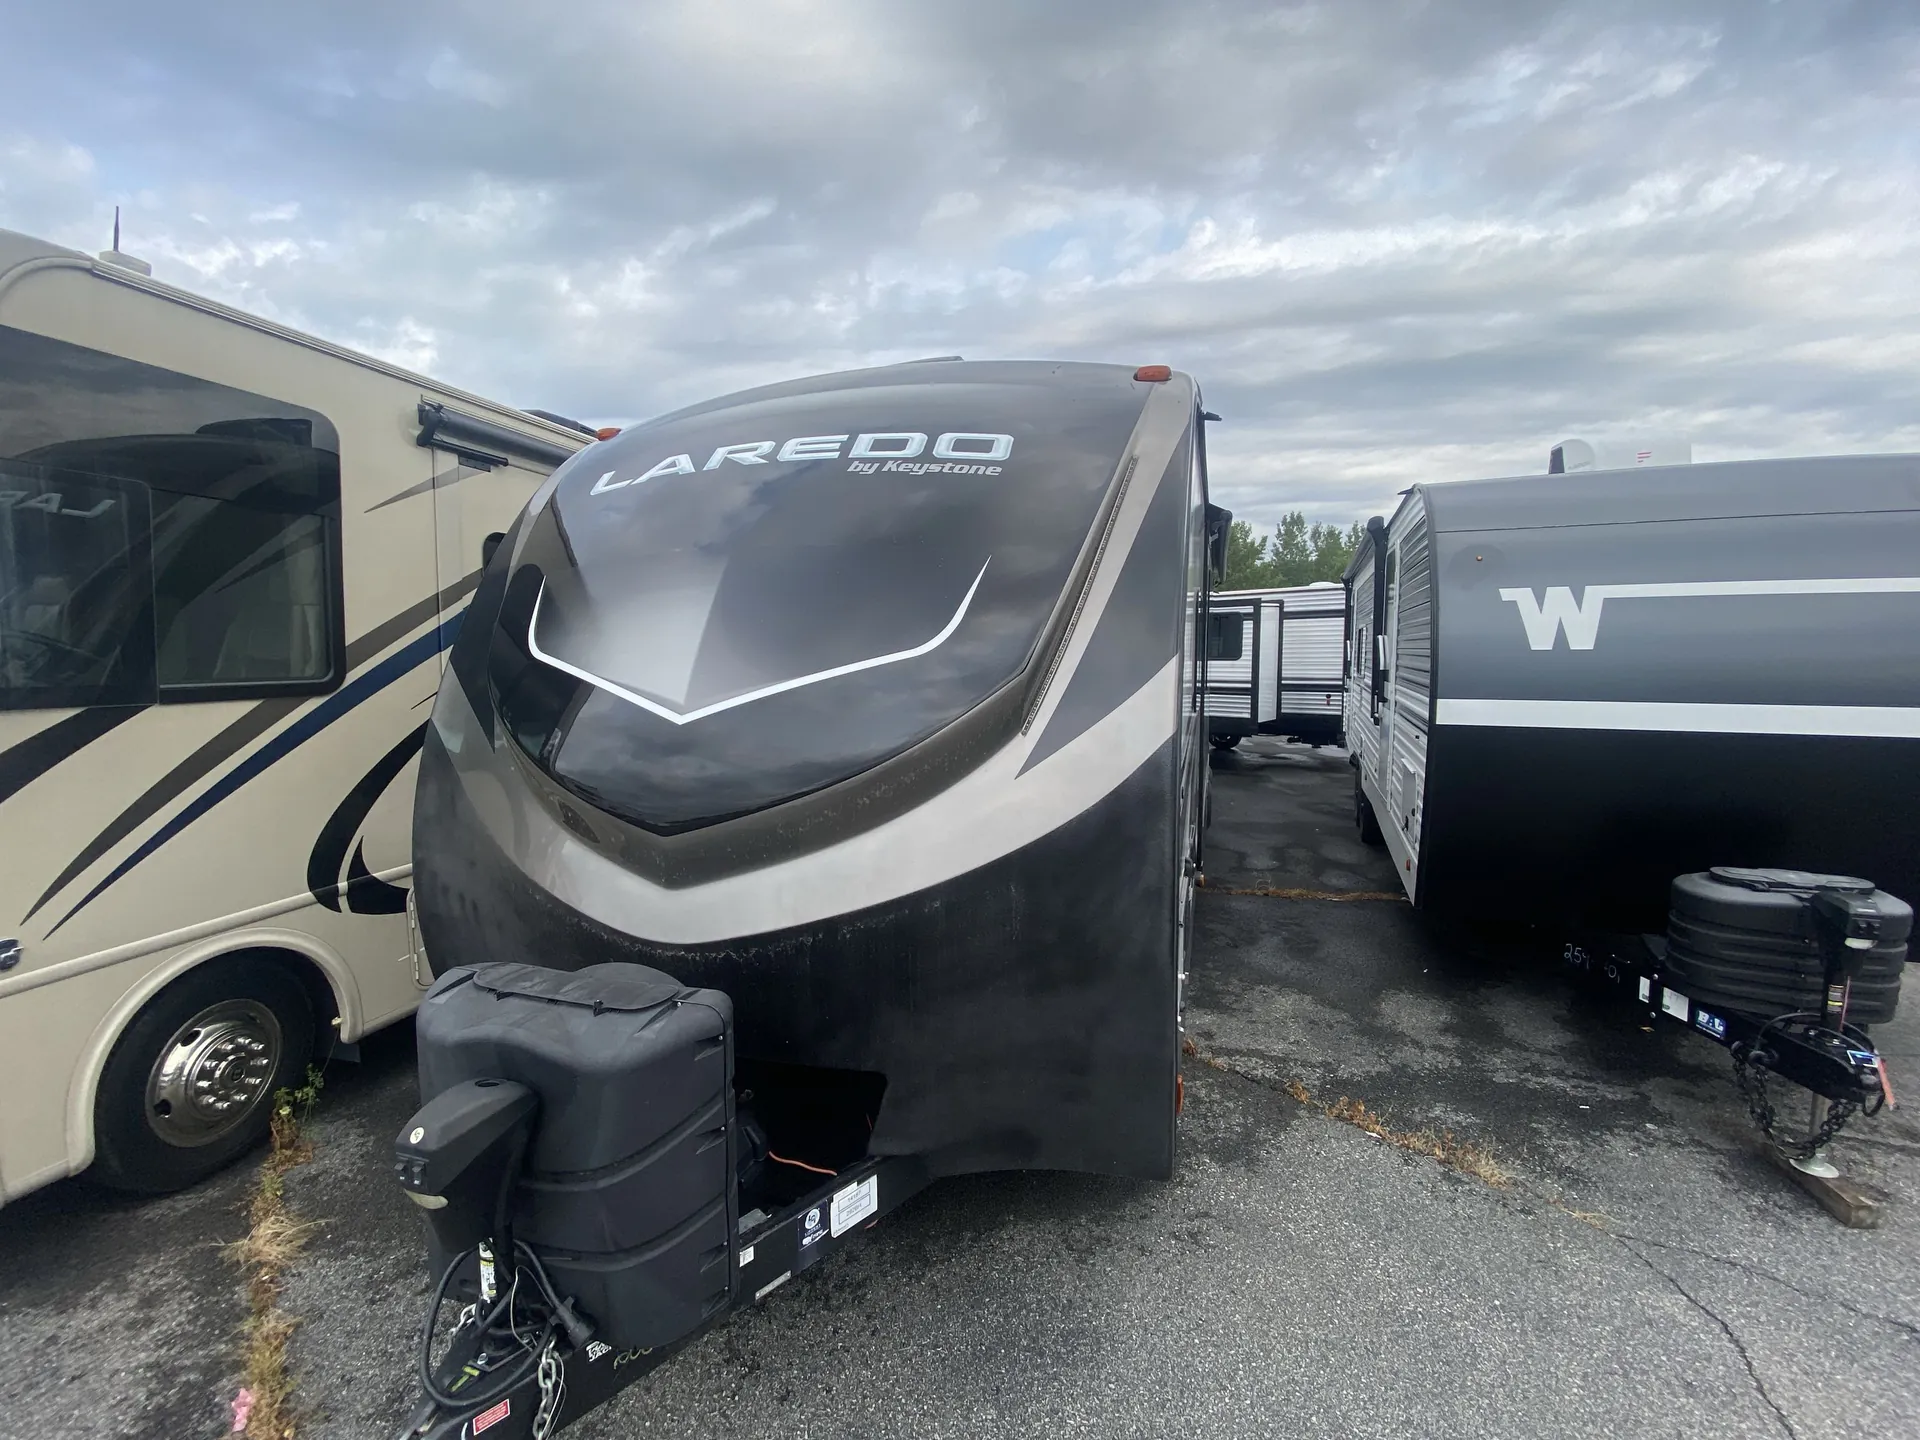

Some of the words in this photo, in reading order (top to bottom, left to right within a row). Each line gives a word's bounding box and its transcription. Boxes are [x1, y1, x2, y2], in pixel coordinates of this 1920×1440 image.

[589, 432, 1015, 496] LAREDO
[847, 460, 882, 474] by
[882, 460, 1003, 476] Keystone
